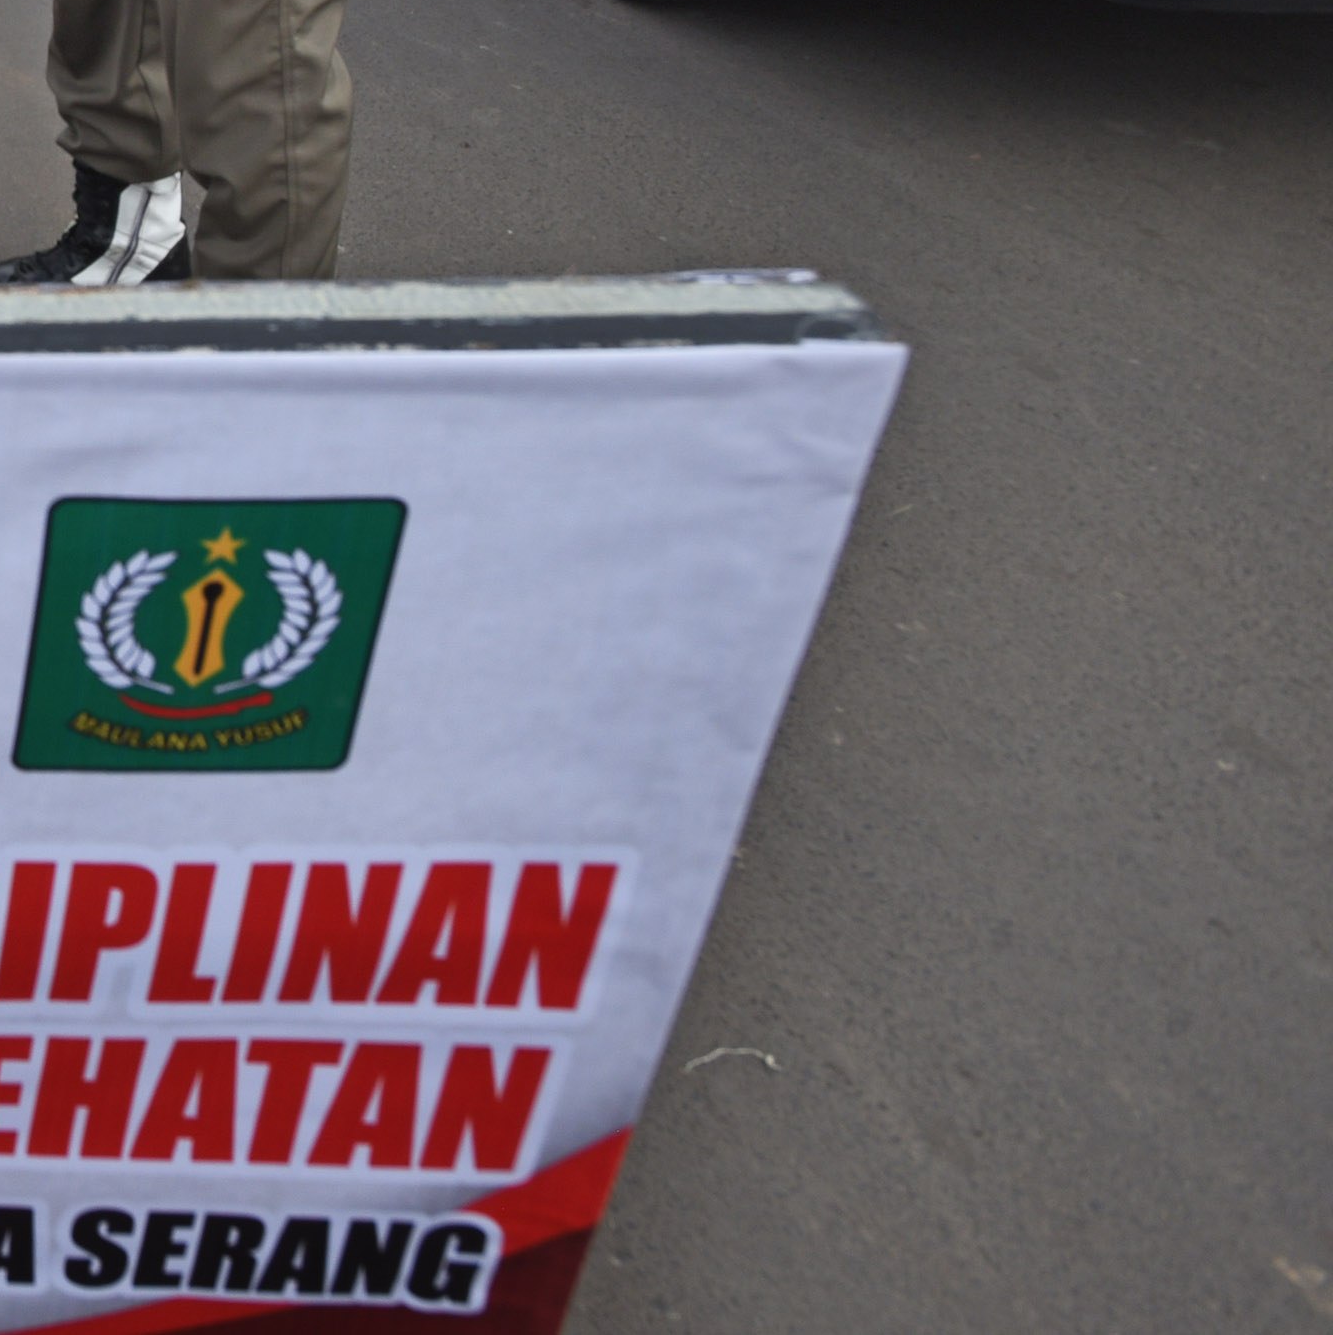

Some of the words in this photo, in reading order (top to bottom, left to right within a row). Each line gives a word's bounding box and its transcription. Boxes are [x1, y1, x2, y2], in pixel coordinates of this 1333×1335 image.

[68, 710, 210, 752] MAULANA
[213, 707, 309, 748] YUSUF
[64, 1208, 488, 1303] SERANG
